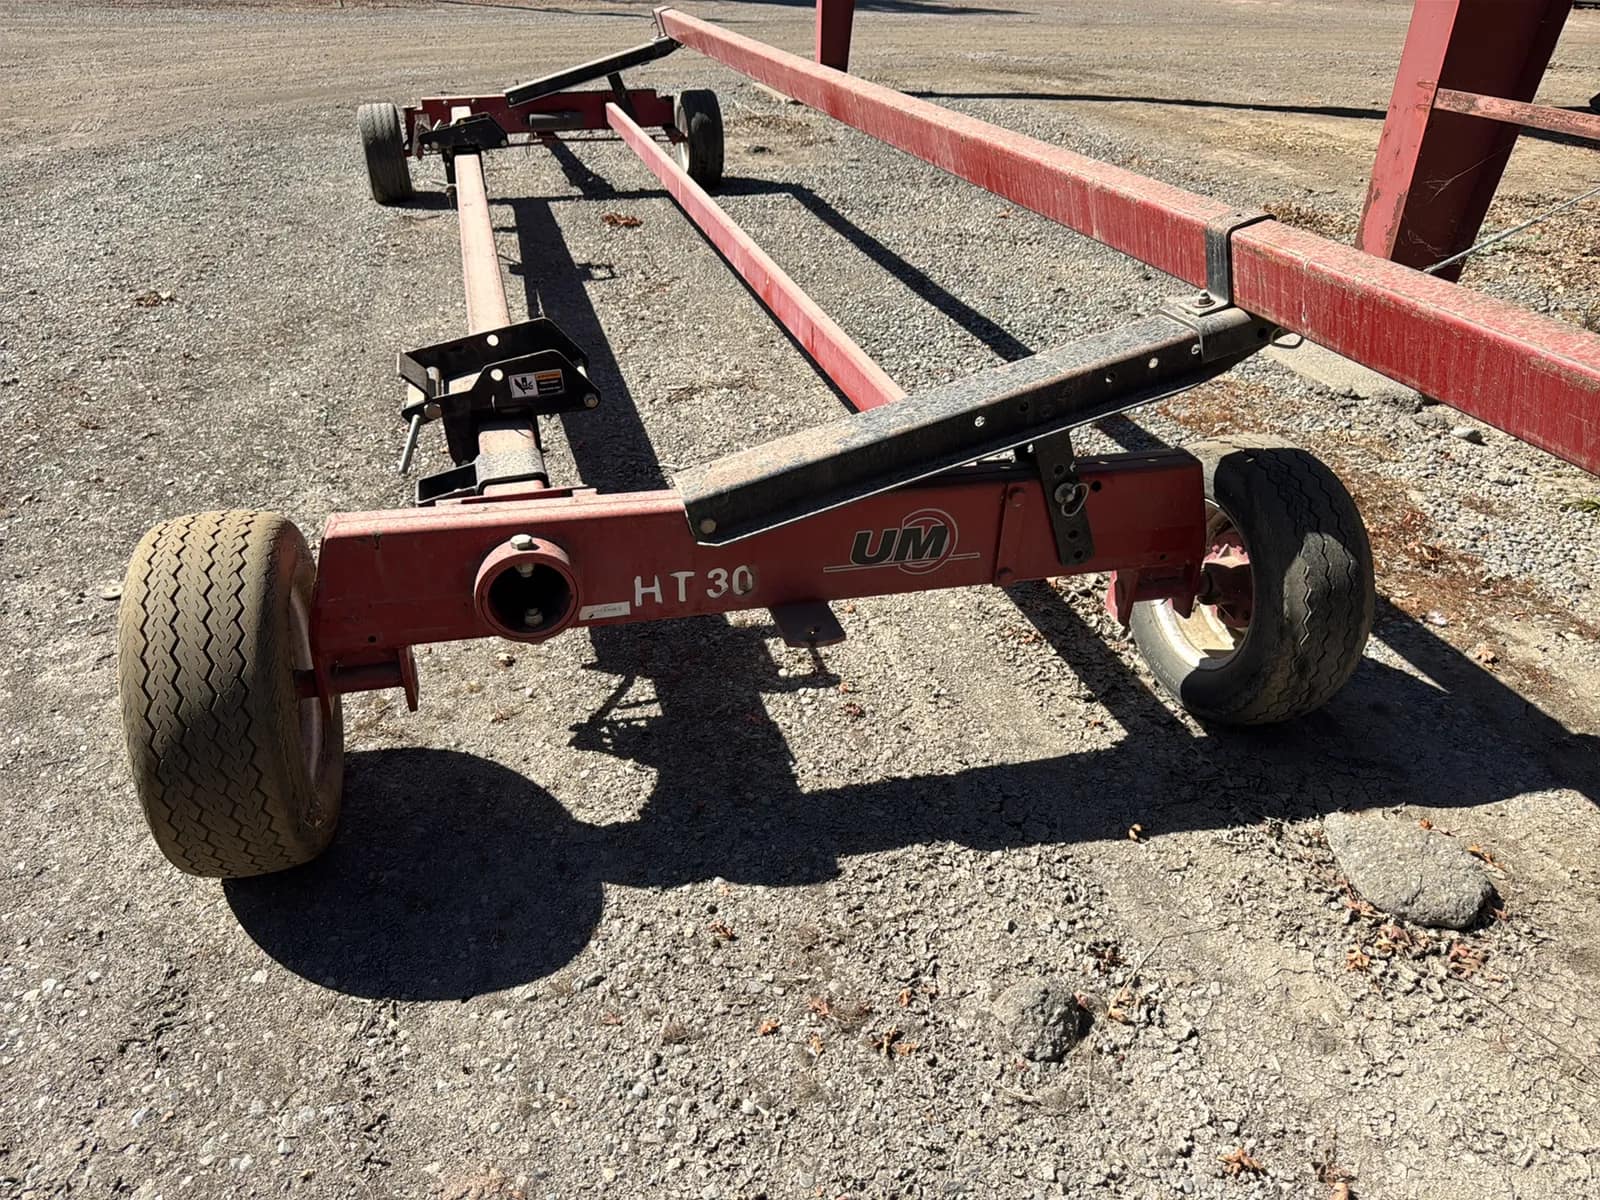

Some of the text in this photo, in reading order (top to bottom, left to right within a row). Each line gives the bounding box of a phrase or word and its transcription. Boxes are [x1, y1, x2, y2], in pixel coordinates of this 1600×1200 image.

[850, 526, 949, 565] UM
[634, 564, 754, 607] HT 30
